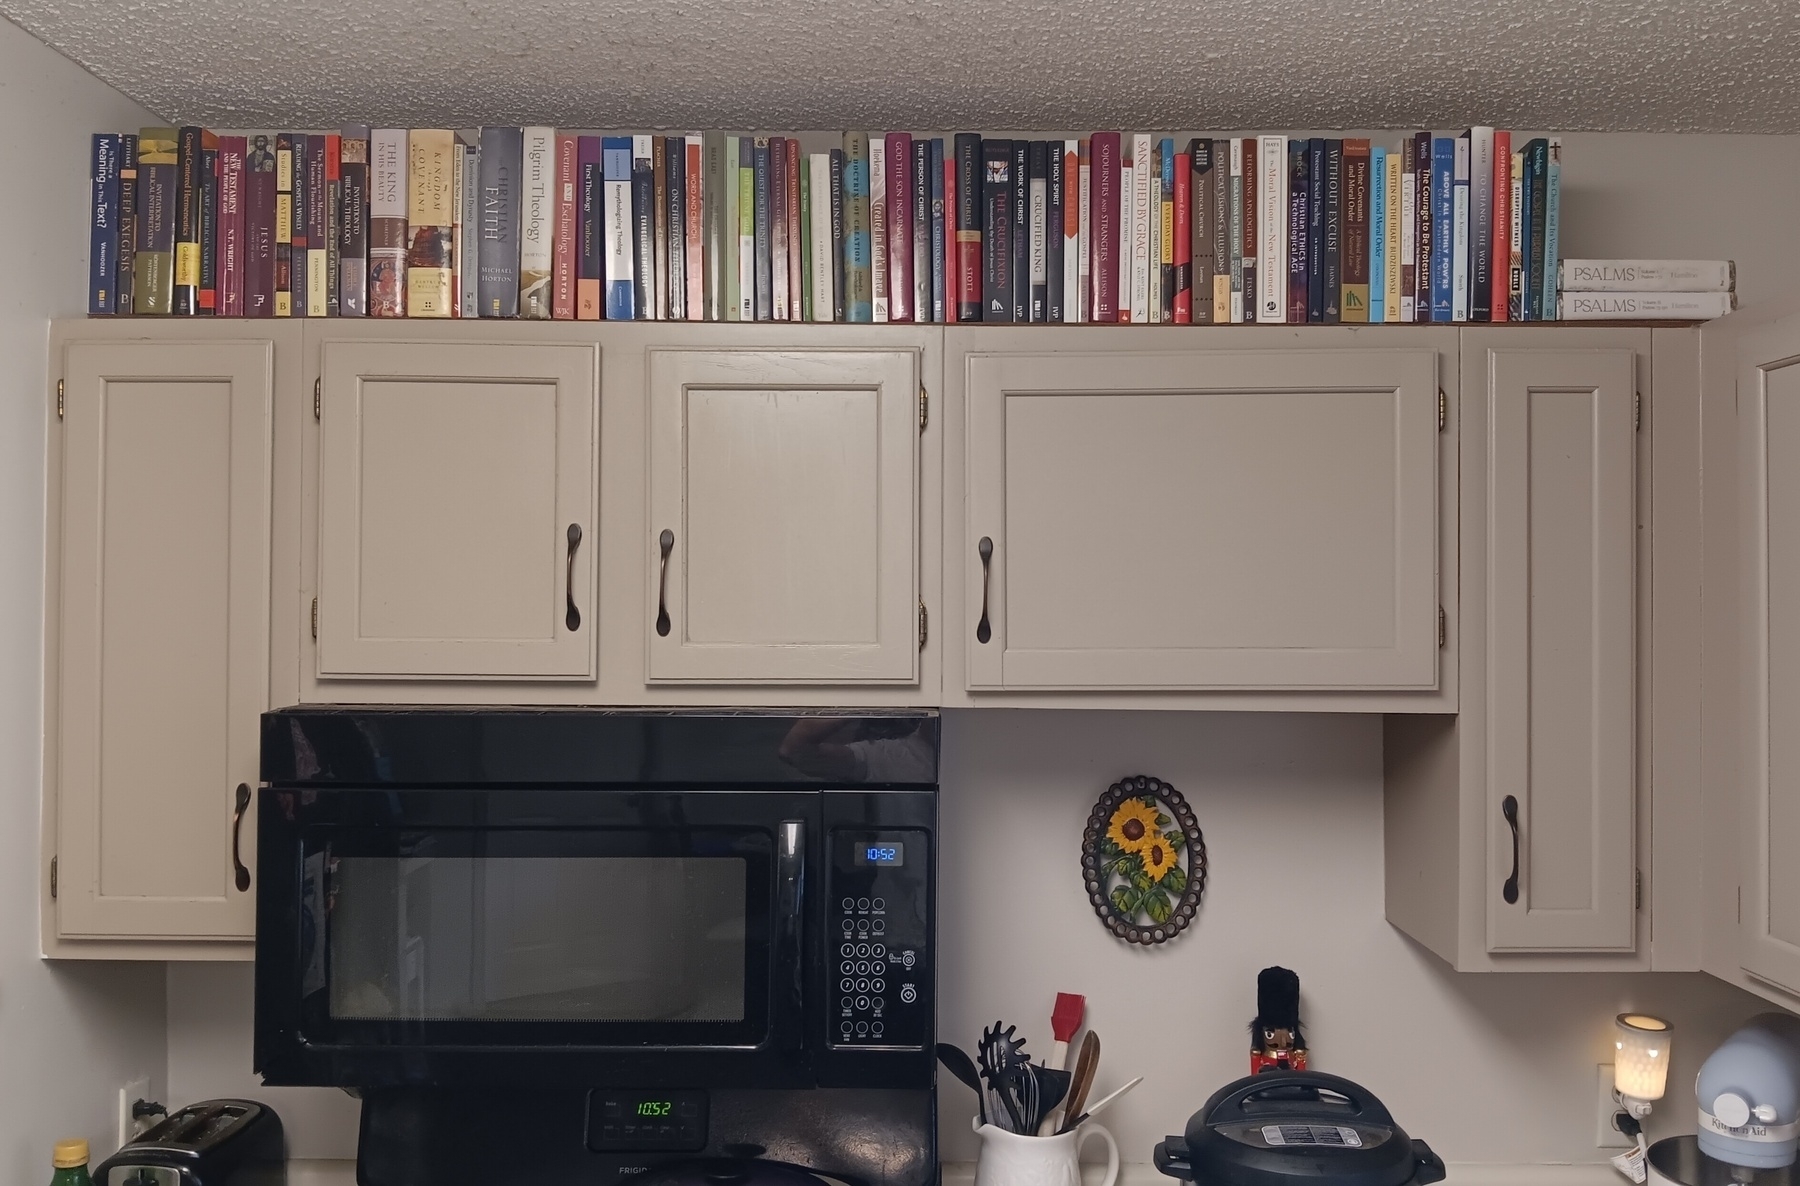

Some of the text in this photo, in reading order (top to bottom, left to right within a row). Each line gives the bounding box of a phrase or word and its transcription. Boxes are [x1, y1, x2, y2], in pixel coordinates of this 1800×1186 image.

[96, 139, 108, 182] Meaning
[184, 133, 192, 188] Gospel-Centered
[379, 142, 384, 153] IN
[1534, 147, 1542, 174] Newbigin
[387, 143, 396, 202] THE KING
[1137, 141, 1147, 210] SANCTIFIED
[1268, 168, 1276, 195] Moral
[1480, 173, 1486, 185] TO
[229, 172, 237, 214] TESTAMENT
[528, 137, 544, 243] Pilgrim Theology
[672, 189, 678, 201] ON
[918, 186, 924, 196] OF
[1018, 188, 1024, 198] OF
[1328, 150, 1338, 252] WITHOUT EXCUSE
[1390, 195, 1397, 206] ON
[97, 202, 107, 228] Text?
[485, 187, 498, 240] FAITH
[498, 167, 508, 243] CHRISTIAN
[834, 208, 839, 217] IN
[874, 202, 884, 232] Created
[1137, 212, 1147, 221] BY
[121, 183, 131, 271] DEEP EXEGESIS
[155, 222, 160, 231] TO
[353, 225, 359, 234] TO
[1290, 199, 1298, 254] Technological
[1420, 169, 1430, 289] The Courage to Be Protestant
[1136, 224, 1146, 260] GRACE
[875, 245, 886, 266] God's
[876, 269, 885, 293] Image
[1268, 255, 1276, 297] Testament
[1574, 268, 1635, 281] PSALMS
[1574, 299, 1636, 312] PSALMS
[866, 848, 896, 860] 10:52
[638, 1102, 671, 1115] 10:52
